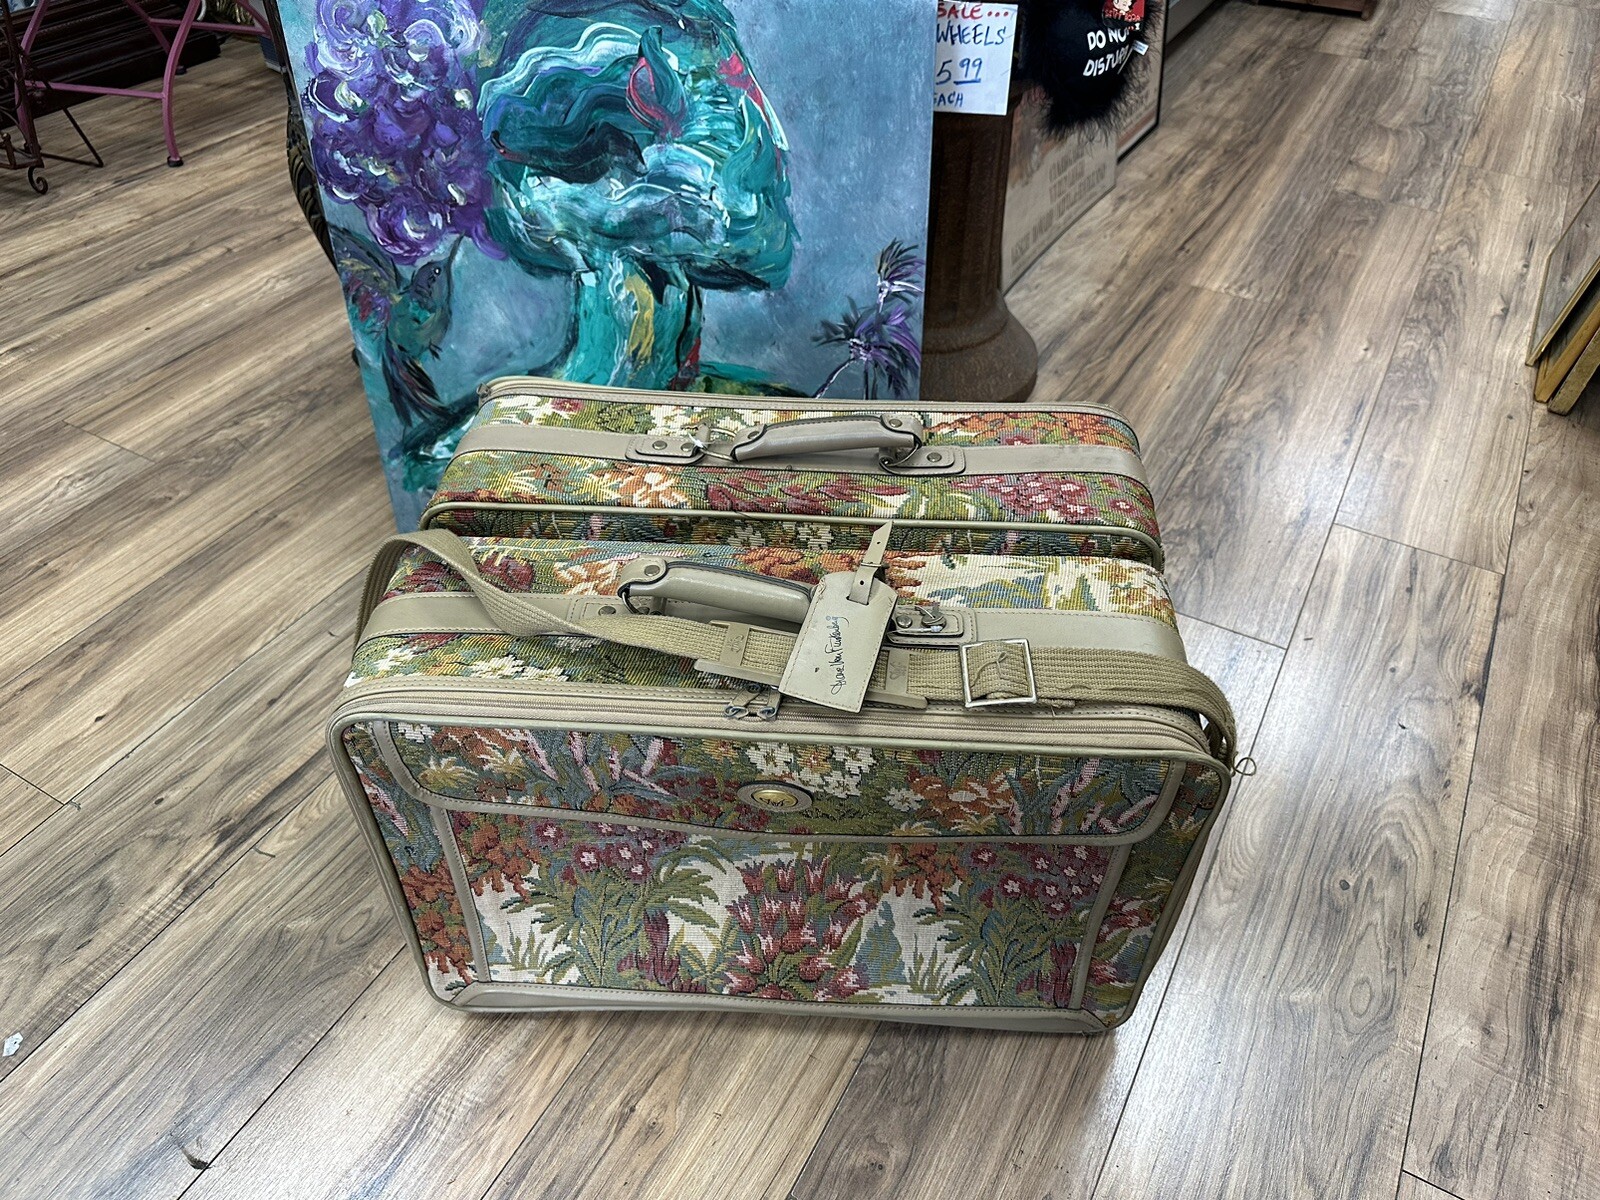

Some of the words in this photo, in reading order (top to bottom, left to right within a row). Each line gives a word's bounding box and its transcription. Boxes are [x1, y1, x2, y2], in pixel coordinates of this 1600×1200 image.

[936, 20, 1006, 46] WHEELS
[1087, 30, 1107, 51] DO
[1107, 27, 1130, 43] NO
